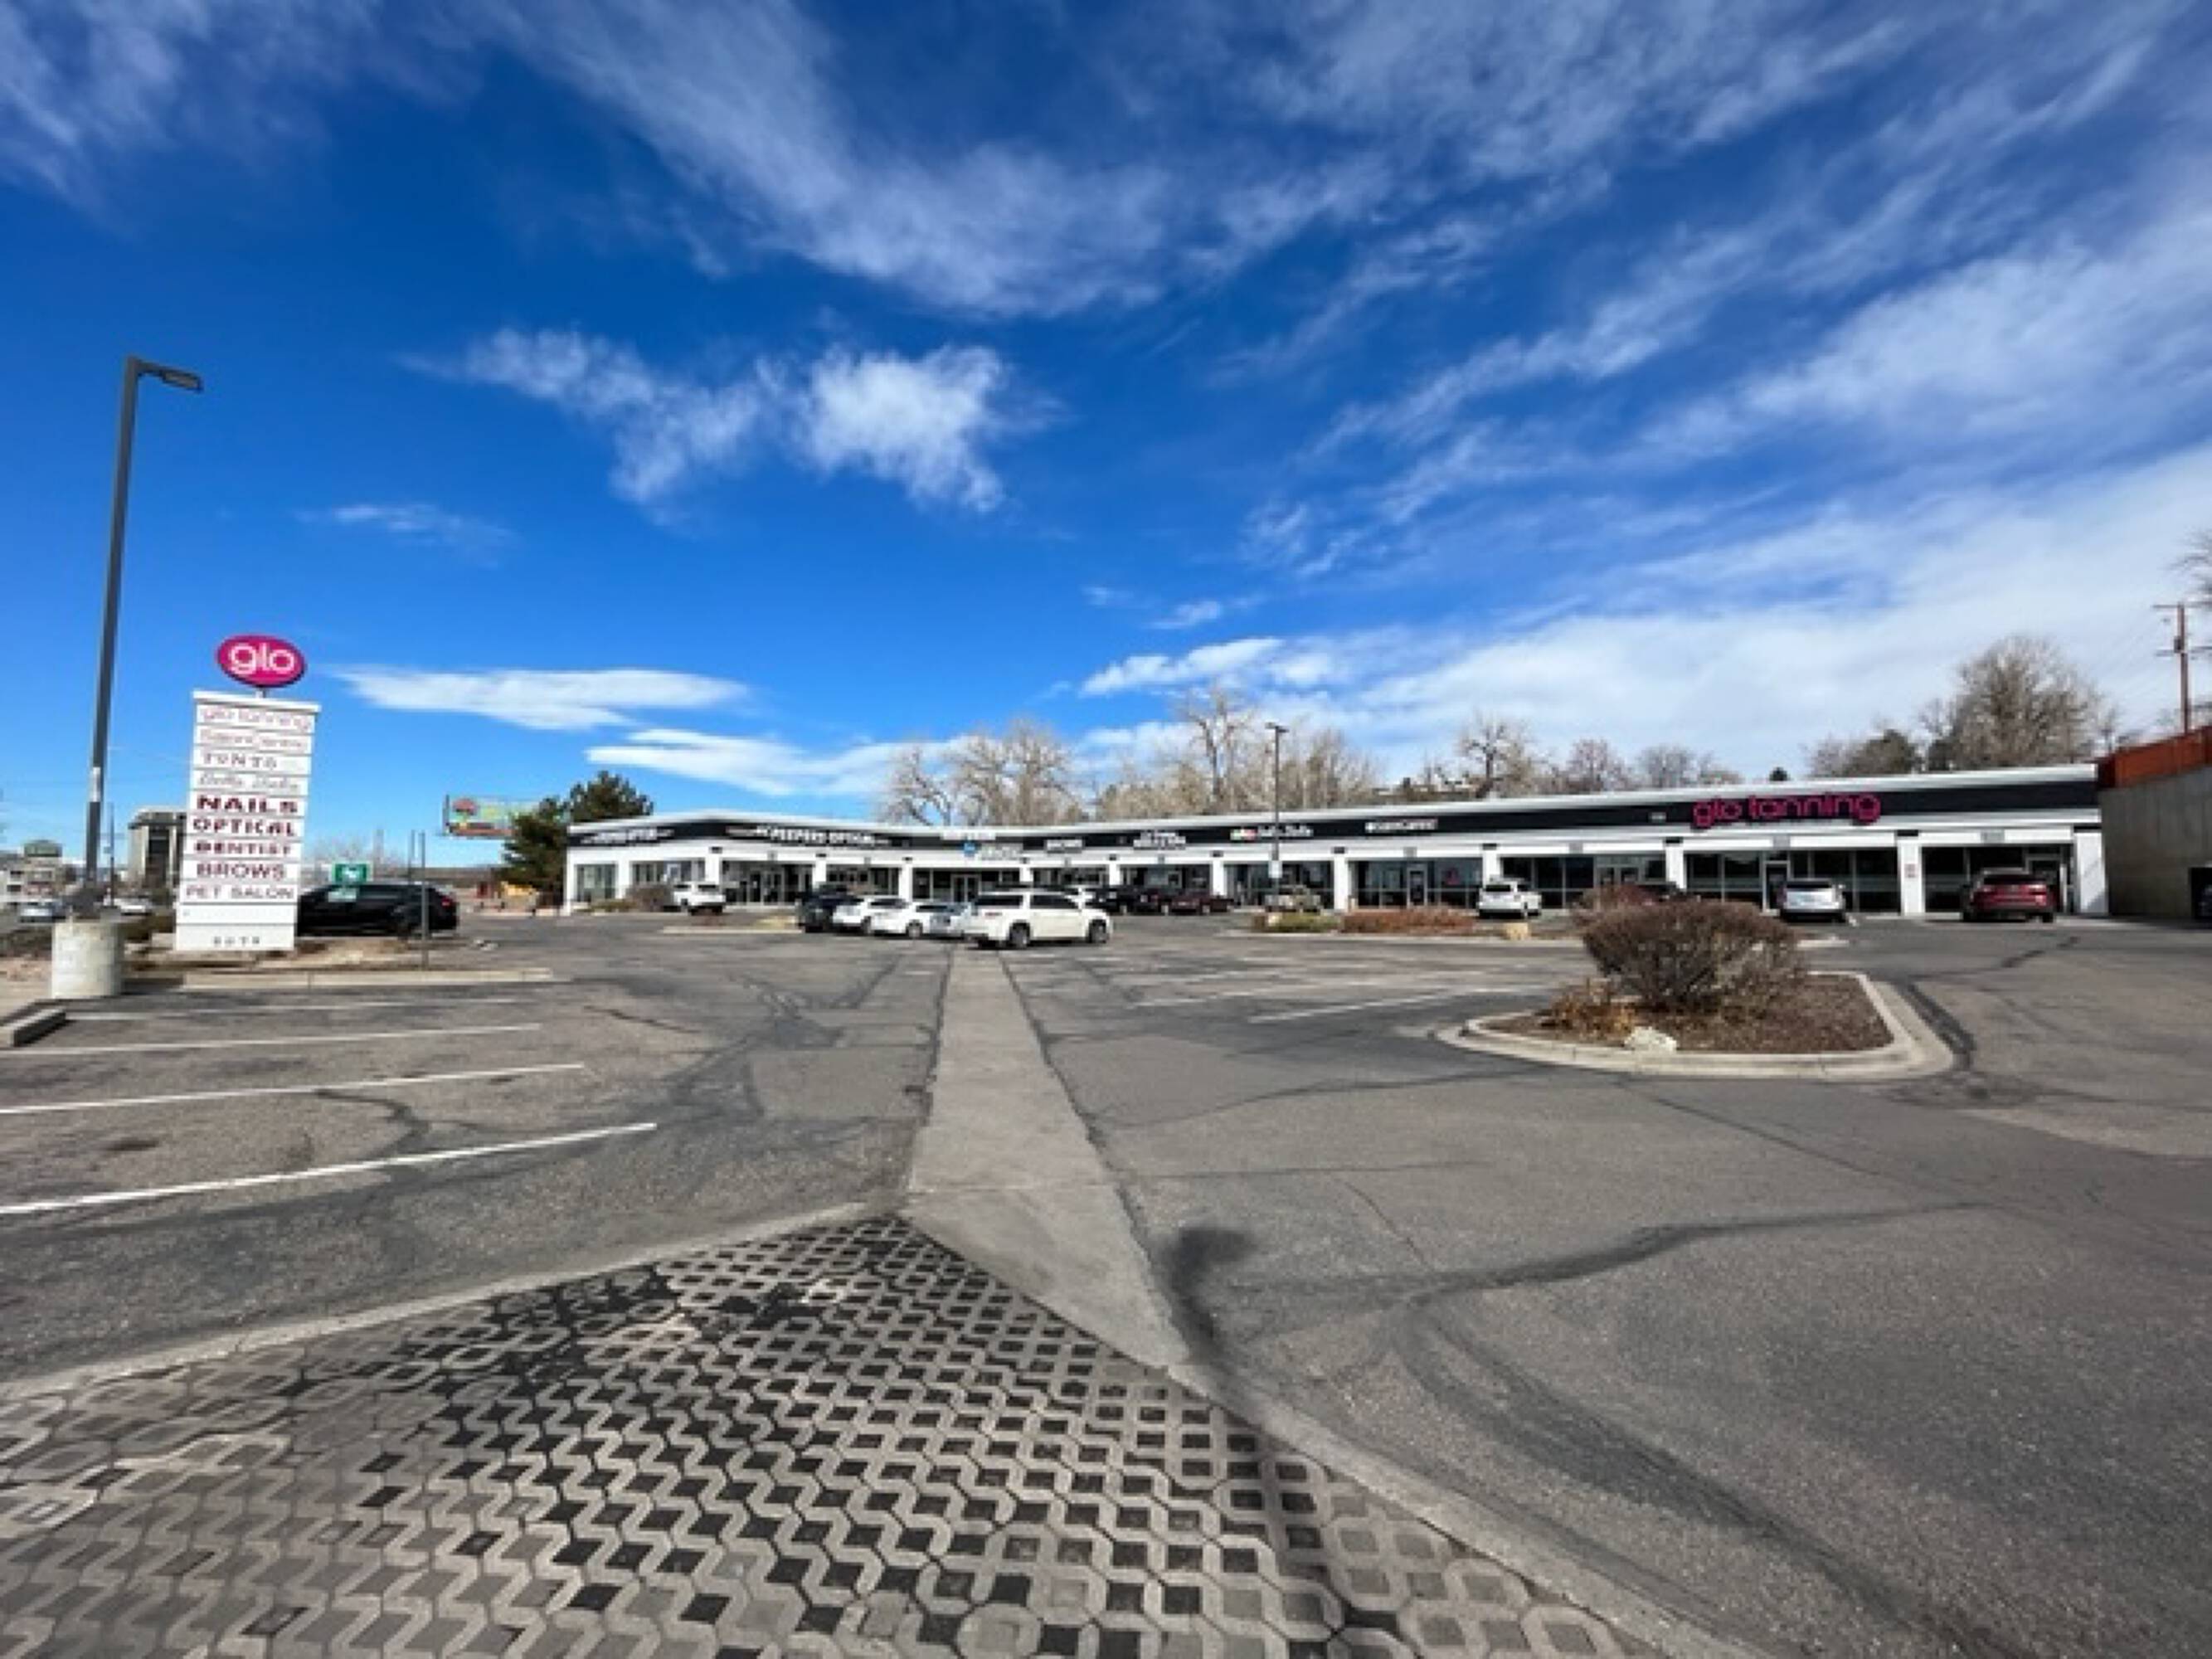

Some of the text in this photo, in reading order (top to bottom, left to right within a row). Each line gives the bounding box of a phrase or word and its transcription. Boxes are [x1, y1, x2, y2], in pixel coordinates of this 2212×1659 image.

[229, 643, 295, 675] glo
[196, 795, 299, 812] NAILS
[1693, 793, 1882, 827] glo tanning
[192, 818, 294, 834] OPTICAL
[194, 841, 290, 855] DENTIST
[196, 863, 284, 879] BROWS
[185, 885, 294, 899] PET SALON
